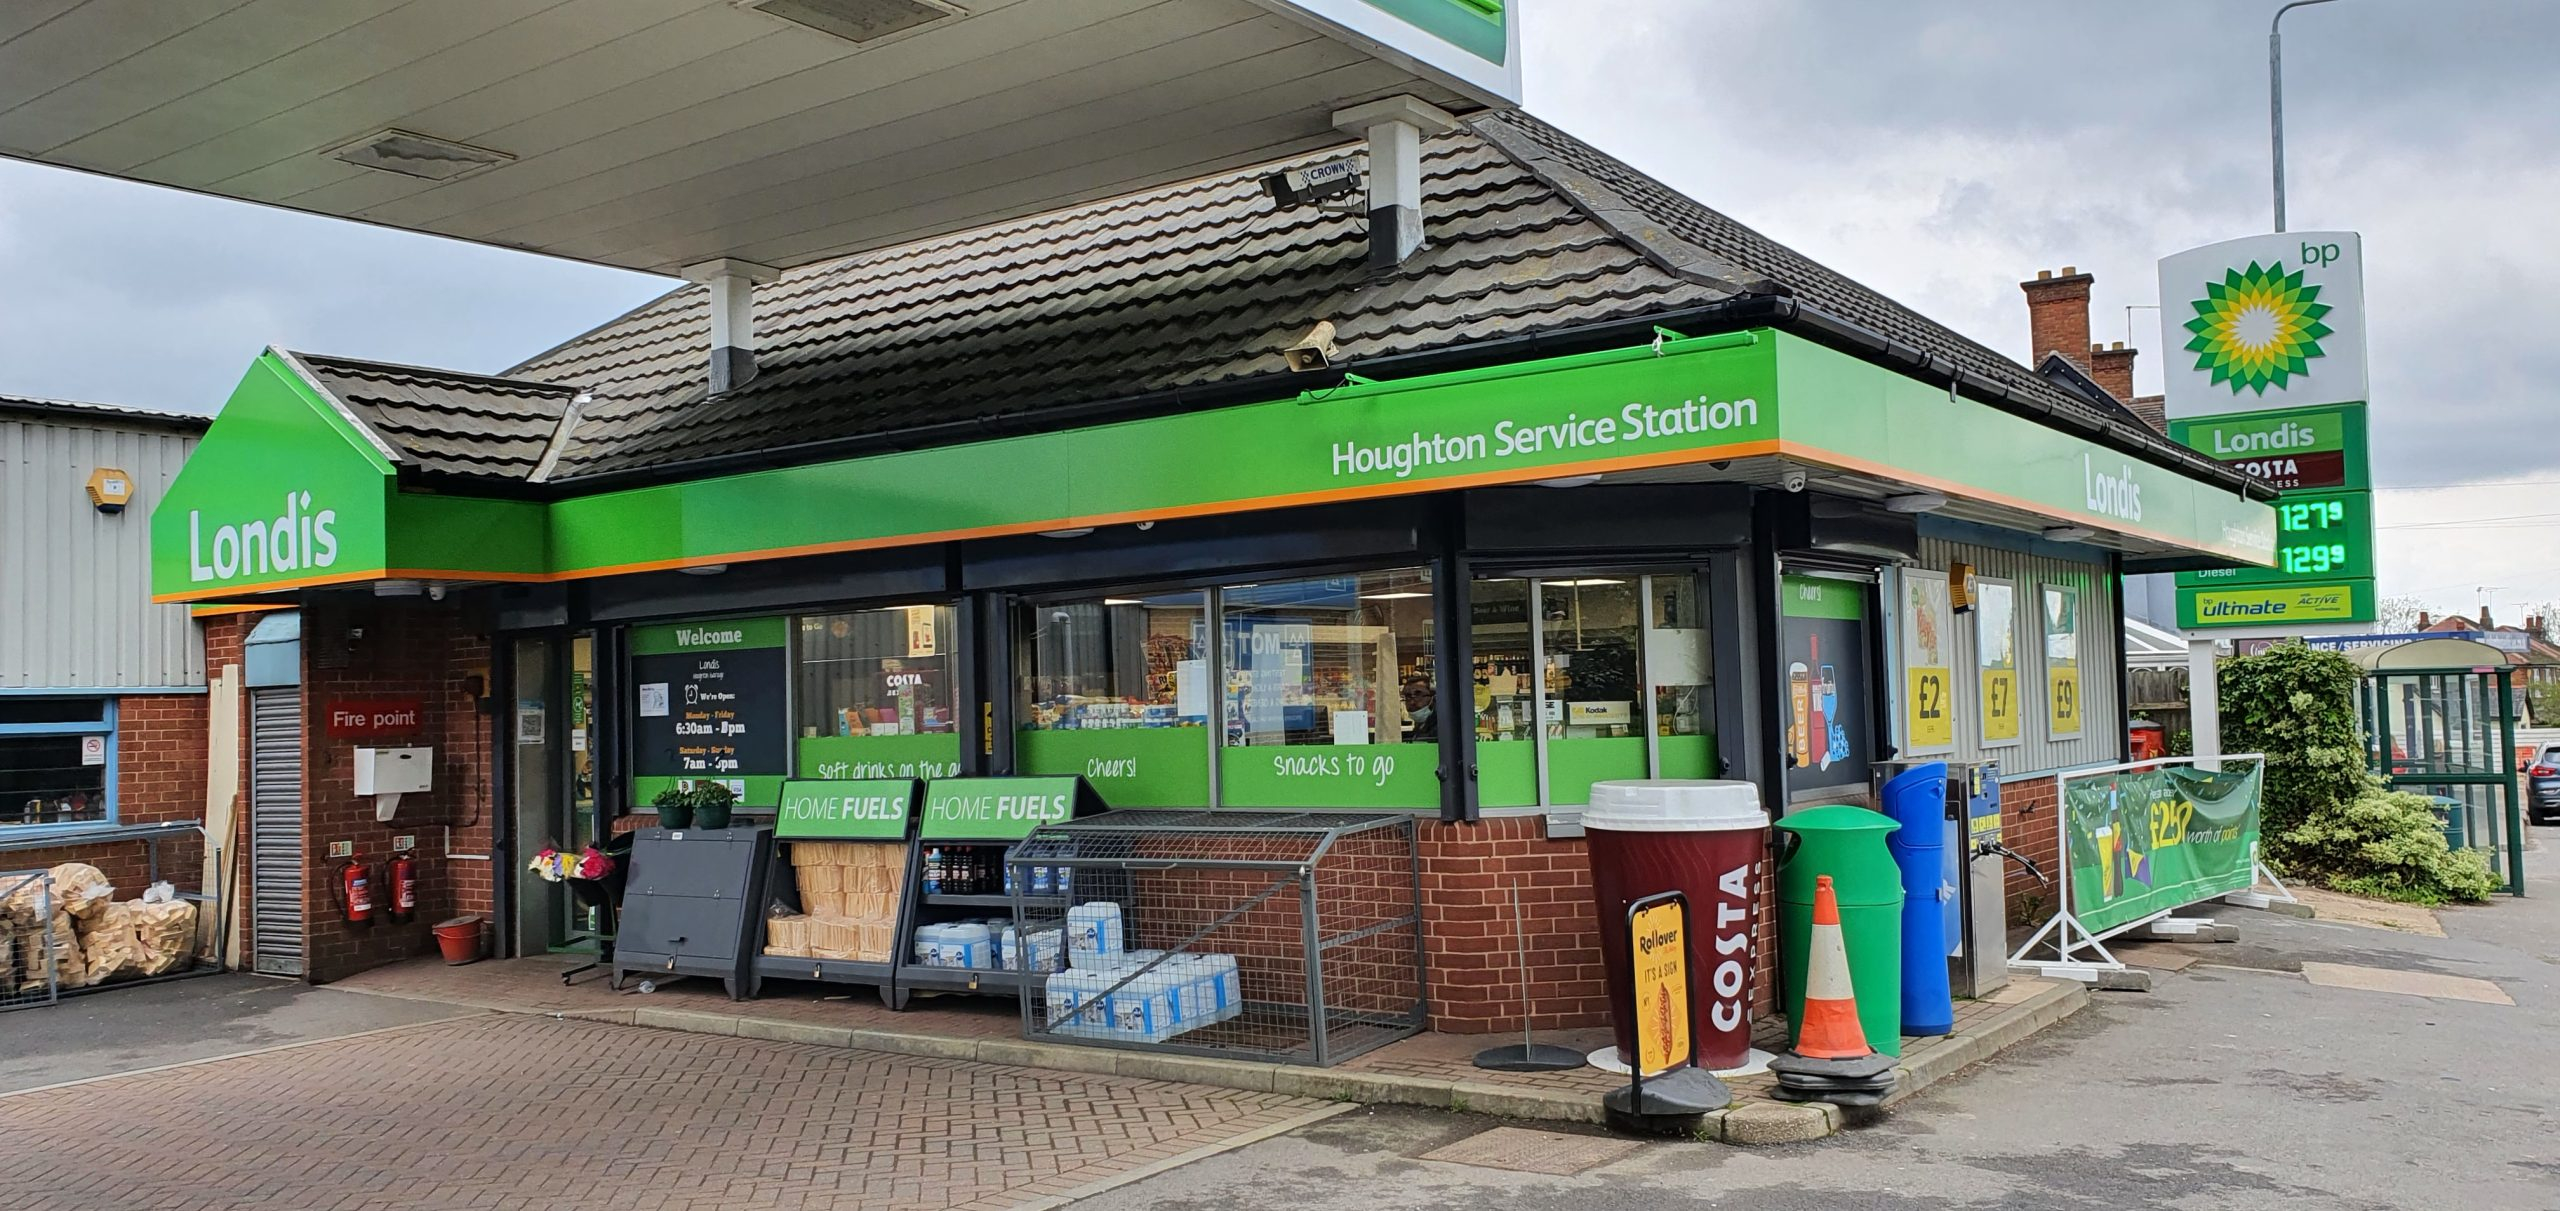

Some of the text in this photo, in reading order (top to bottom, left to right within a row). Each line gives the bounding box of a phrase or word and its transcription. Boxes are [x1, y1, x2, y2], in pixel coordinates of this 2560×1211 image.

[1310, 163, 1345, 180] CROWN
[2301, 241, 2340, 269] bp
[1332, 395, 1758, 478] Houghton Service Station
[2214, 422, 2316, 454] Londis
[2084, 452, 2142, 523] Londis
[189, 489, 337, 582] Londis
[2203, 600, 2287, 617] ultimate
[2297, 595, 2340, 605] ACTIVE
[675, 627, 743, 647] Welcome
[886, 673, 923, 687] COSTA
[700, 692, 717, 701] We're
[1919, 674, 1941, 719] £2
[1991, 677, 2008, 718] £7
[2056, 679, 2073, 719] £9
[333, 709, 416, 729] Fire point
[714, 710, 735, 720] Friday
[1585, 706, 1608, 714] Kodak
[675, 722, 713, 735] 6:30am
[683, 757, 706, 769] 7am
[852, 760, 894, 779] drinks
[899, 762, 914, 778] on
[919, 760, 943, 779] the
[1346, 752, 1365, 776] to
[1372, 755, 1395, 787] go
[784, 796, 905, 820] HOME FUELS
[931, 794, 1066, 821] HOME FUELS
[1639, 929, 1678, 955] Rollover
[1711, 863, 1748, 1033] COSTA
[1644, 960, 1678, 983] IT'S A SIGN
